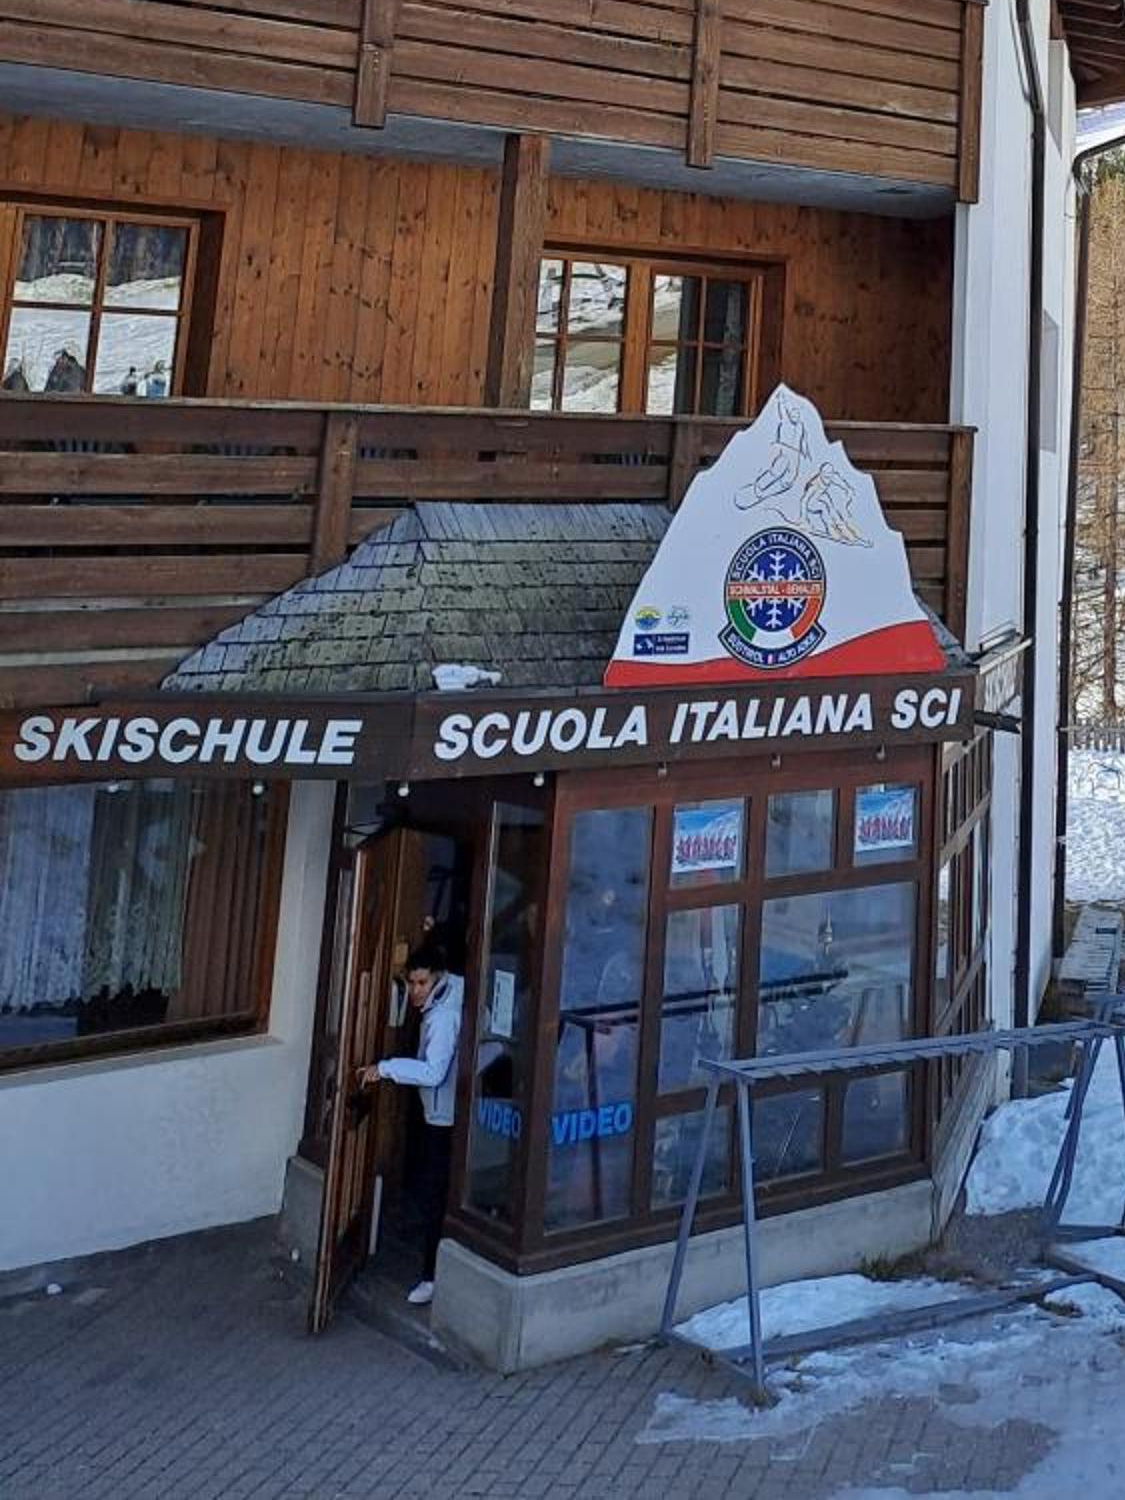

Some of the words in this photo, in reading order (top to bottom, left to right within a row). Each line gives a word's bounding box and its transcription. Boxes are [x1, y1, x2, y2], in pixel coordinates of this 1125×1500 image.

[14, 716, 363, 765] SKISCHULE
[434, 705, 648, 760] SCUOLA
[669, 693, 874, 744] ITALIANA
[891, 687, 963, 730] SCI
[477, 1098, 522, 1139] VIDEO
[552, 1103, 633, 1147] VIDEO
